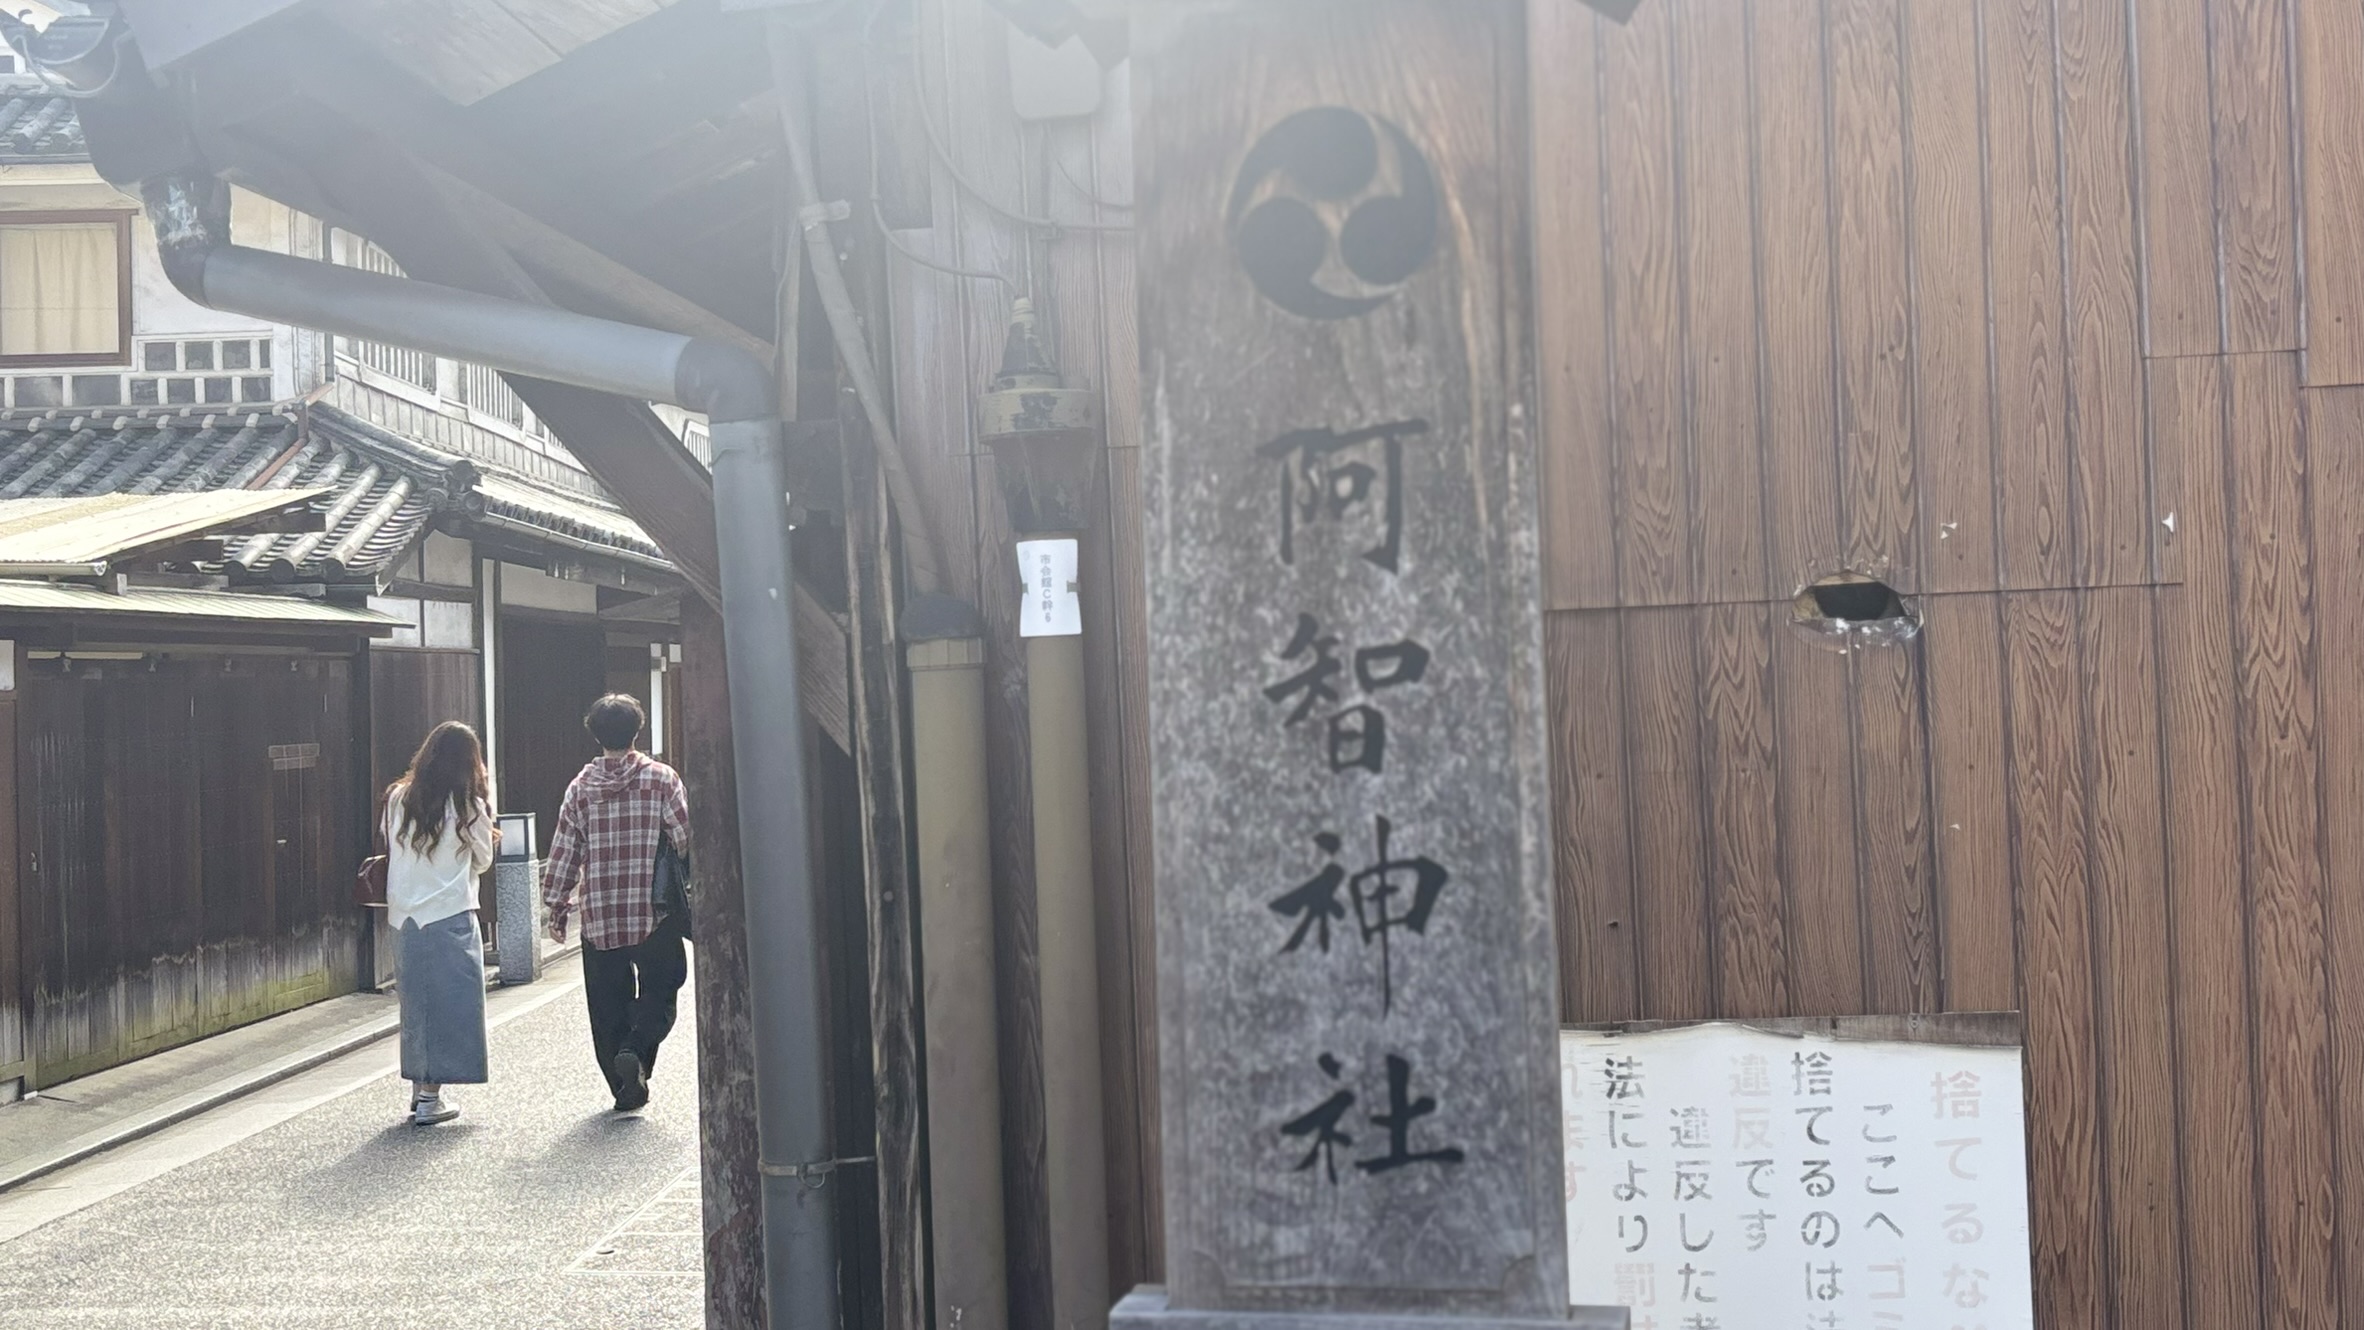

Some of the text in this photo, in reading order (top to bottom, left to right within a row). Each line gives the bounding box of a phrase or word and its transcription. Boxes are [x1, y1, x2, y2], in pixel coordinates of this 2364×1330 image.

[1254, 418, 1465, 1186] 阿智神社
[1729, 1054, 1776, 1252] 違反です
[1930, 1070, 1990, 1330] 捨てるな
